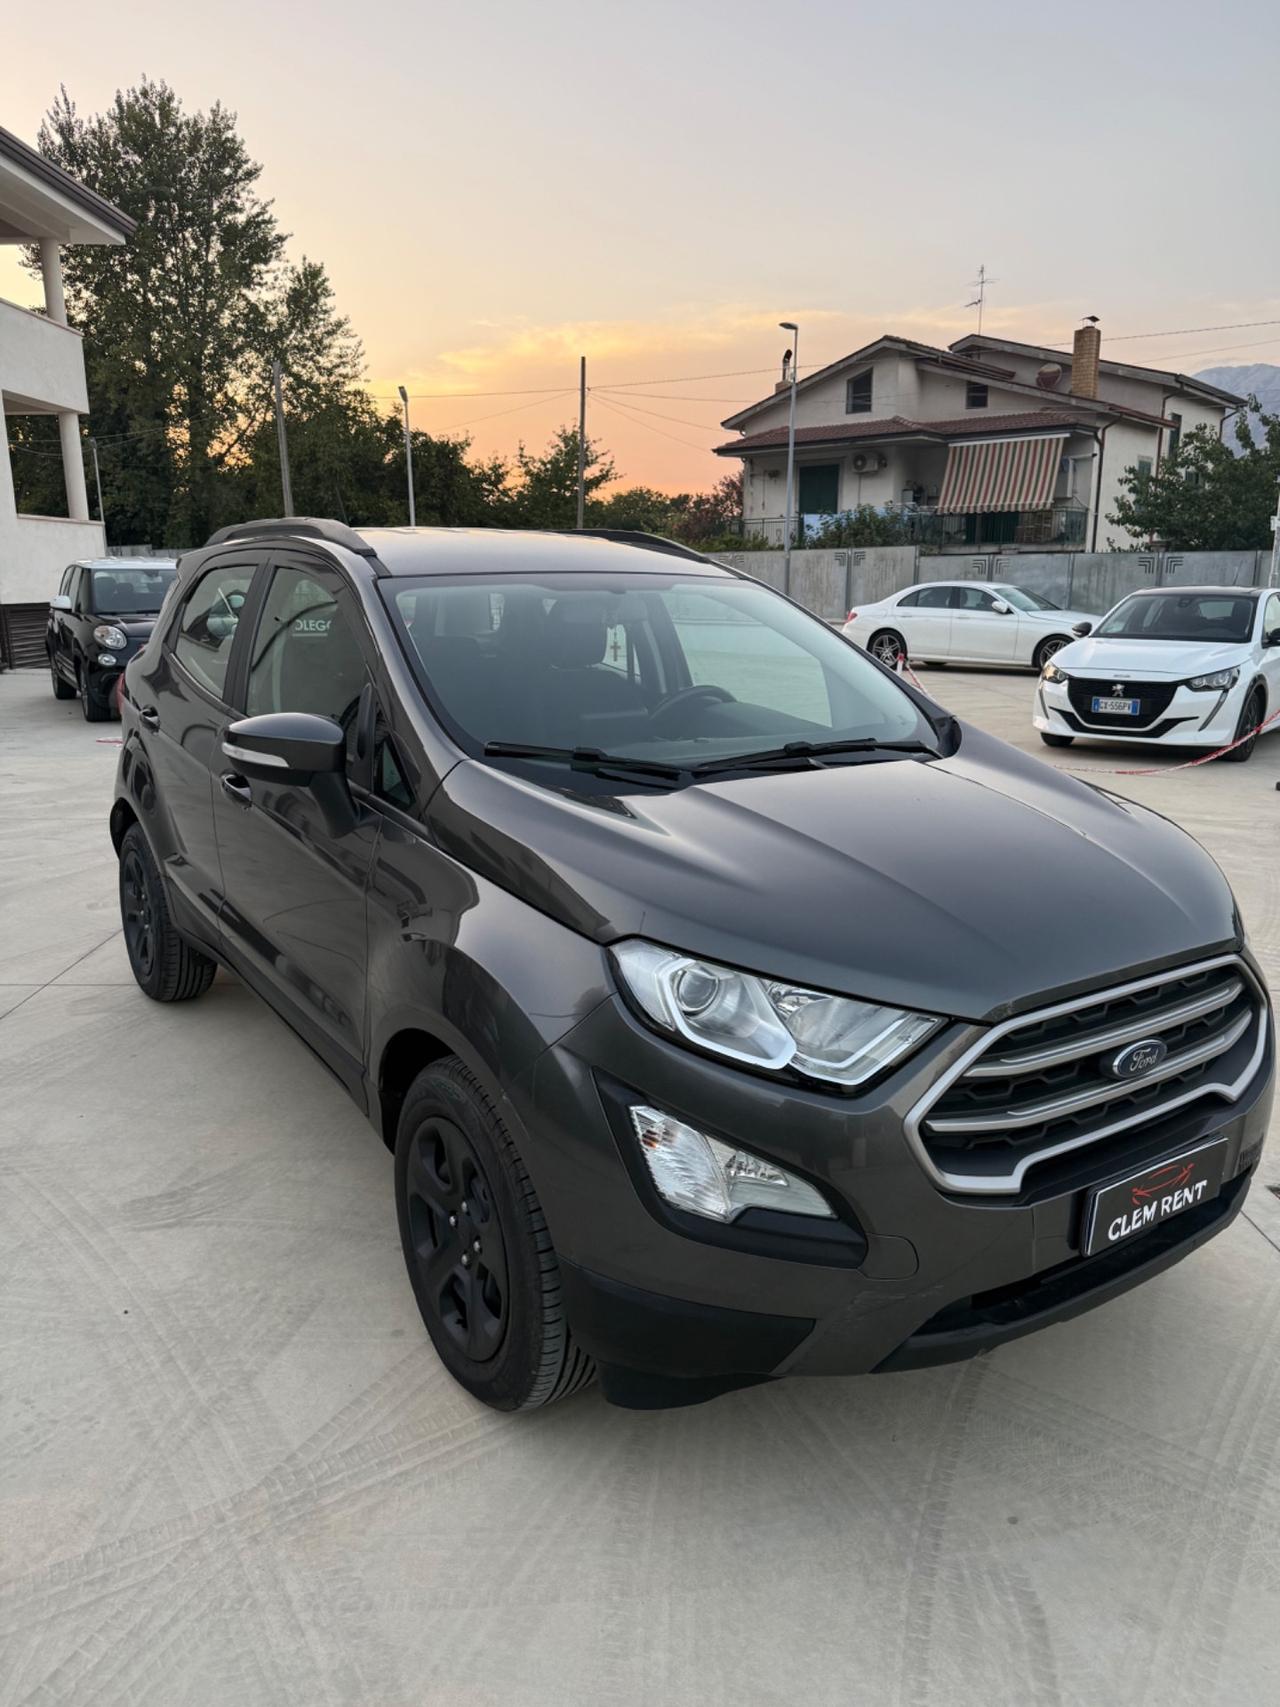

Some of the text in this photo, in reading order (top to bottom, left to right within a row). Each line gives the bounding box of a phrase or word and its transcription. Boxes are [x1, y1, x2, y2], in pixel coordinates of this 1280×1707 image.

[1130, 1047, 1159, 1071] Ford
[1108, 1179, 1208, 1241] CLEM RENT
